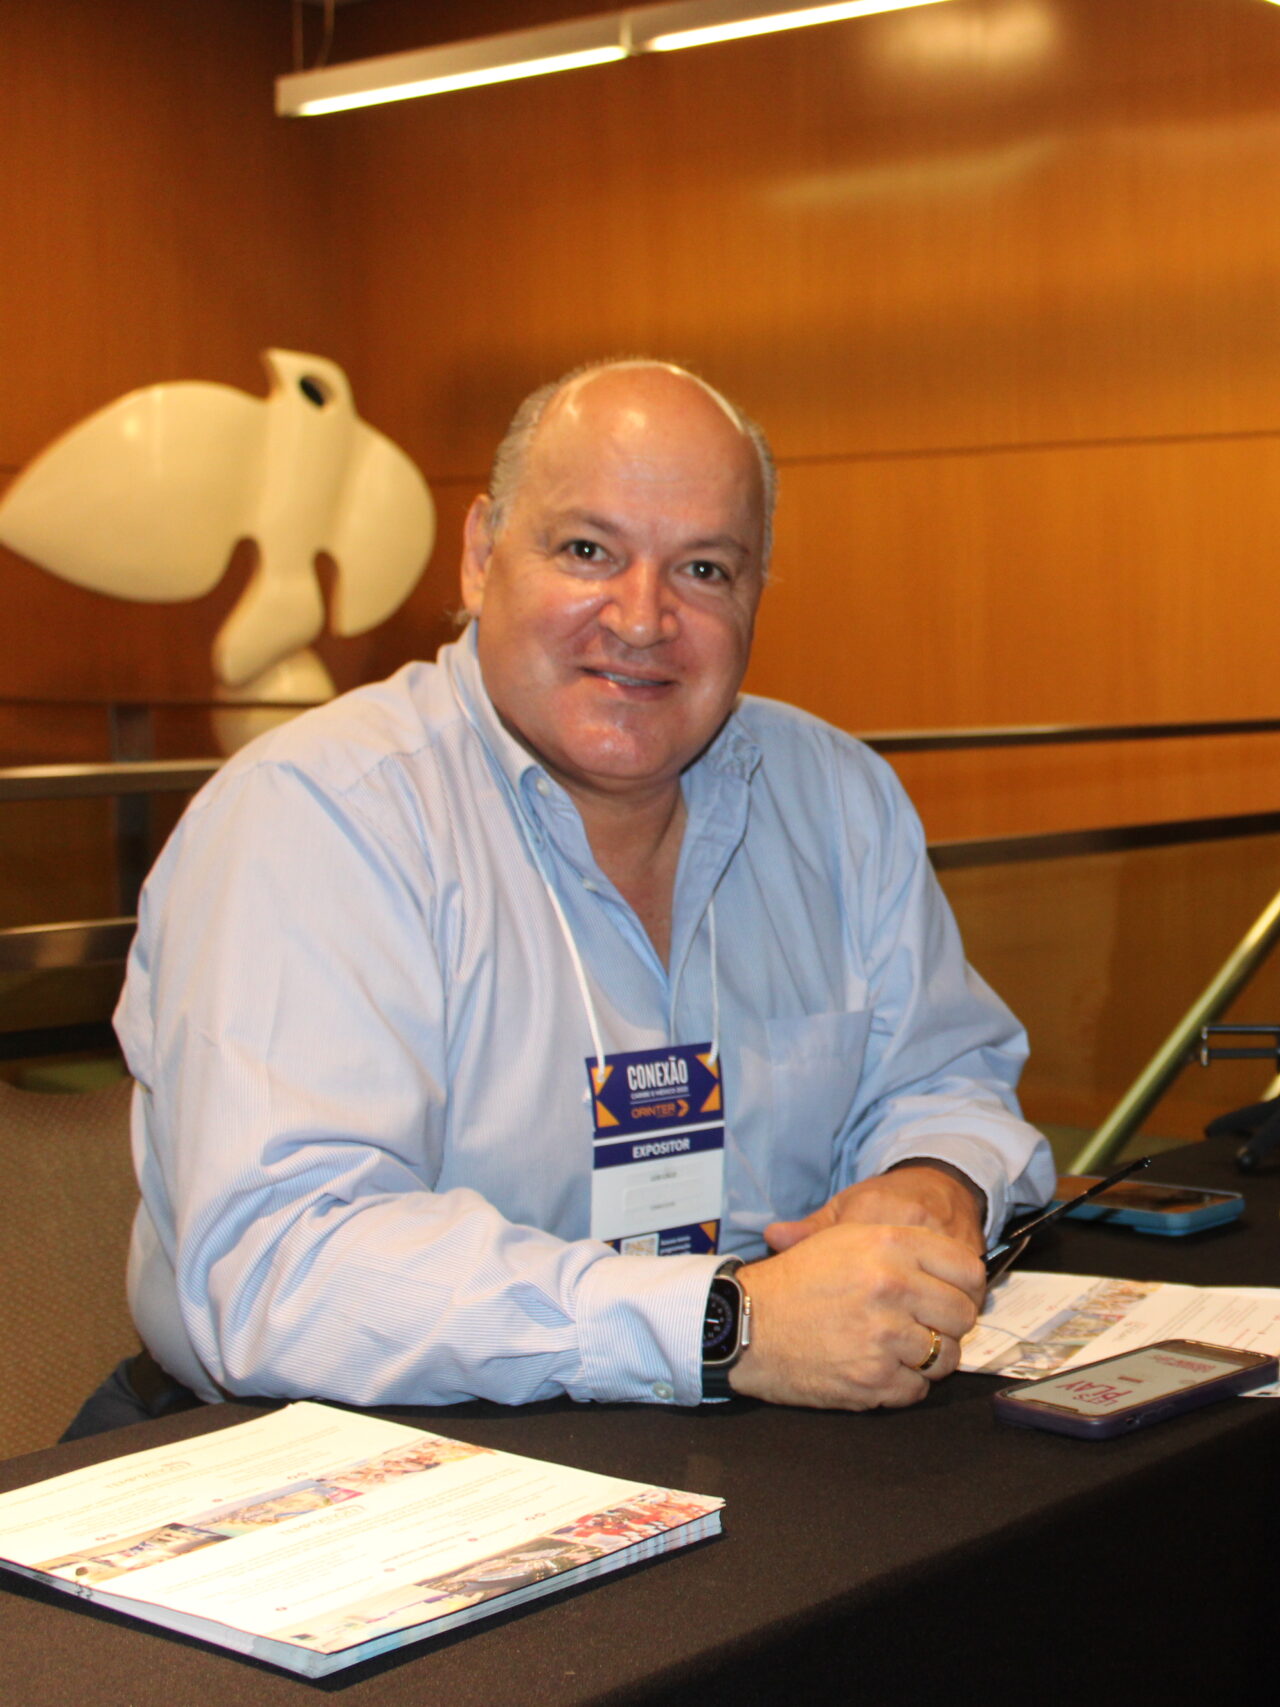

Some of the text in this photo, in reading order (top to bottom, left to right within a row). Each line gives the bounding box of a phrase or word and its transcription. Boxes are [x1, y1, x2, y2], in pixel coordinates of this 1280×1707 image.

[626, 1056, 689, 1091] CONEXÃO
[632, 1137, 691, 1159] EXPOSITOR
[1055, 1380, 1133, 1402] PLAY
